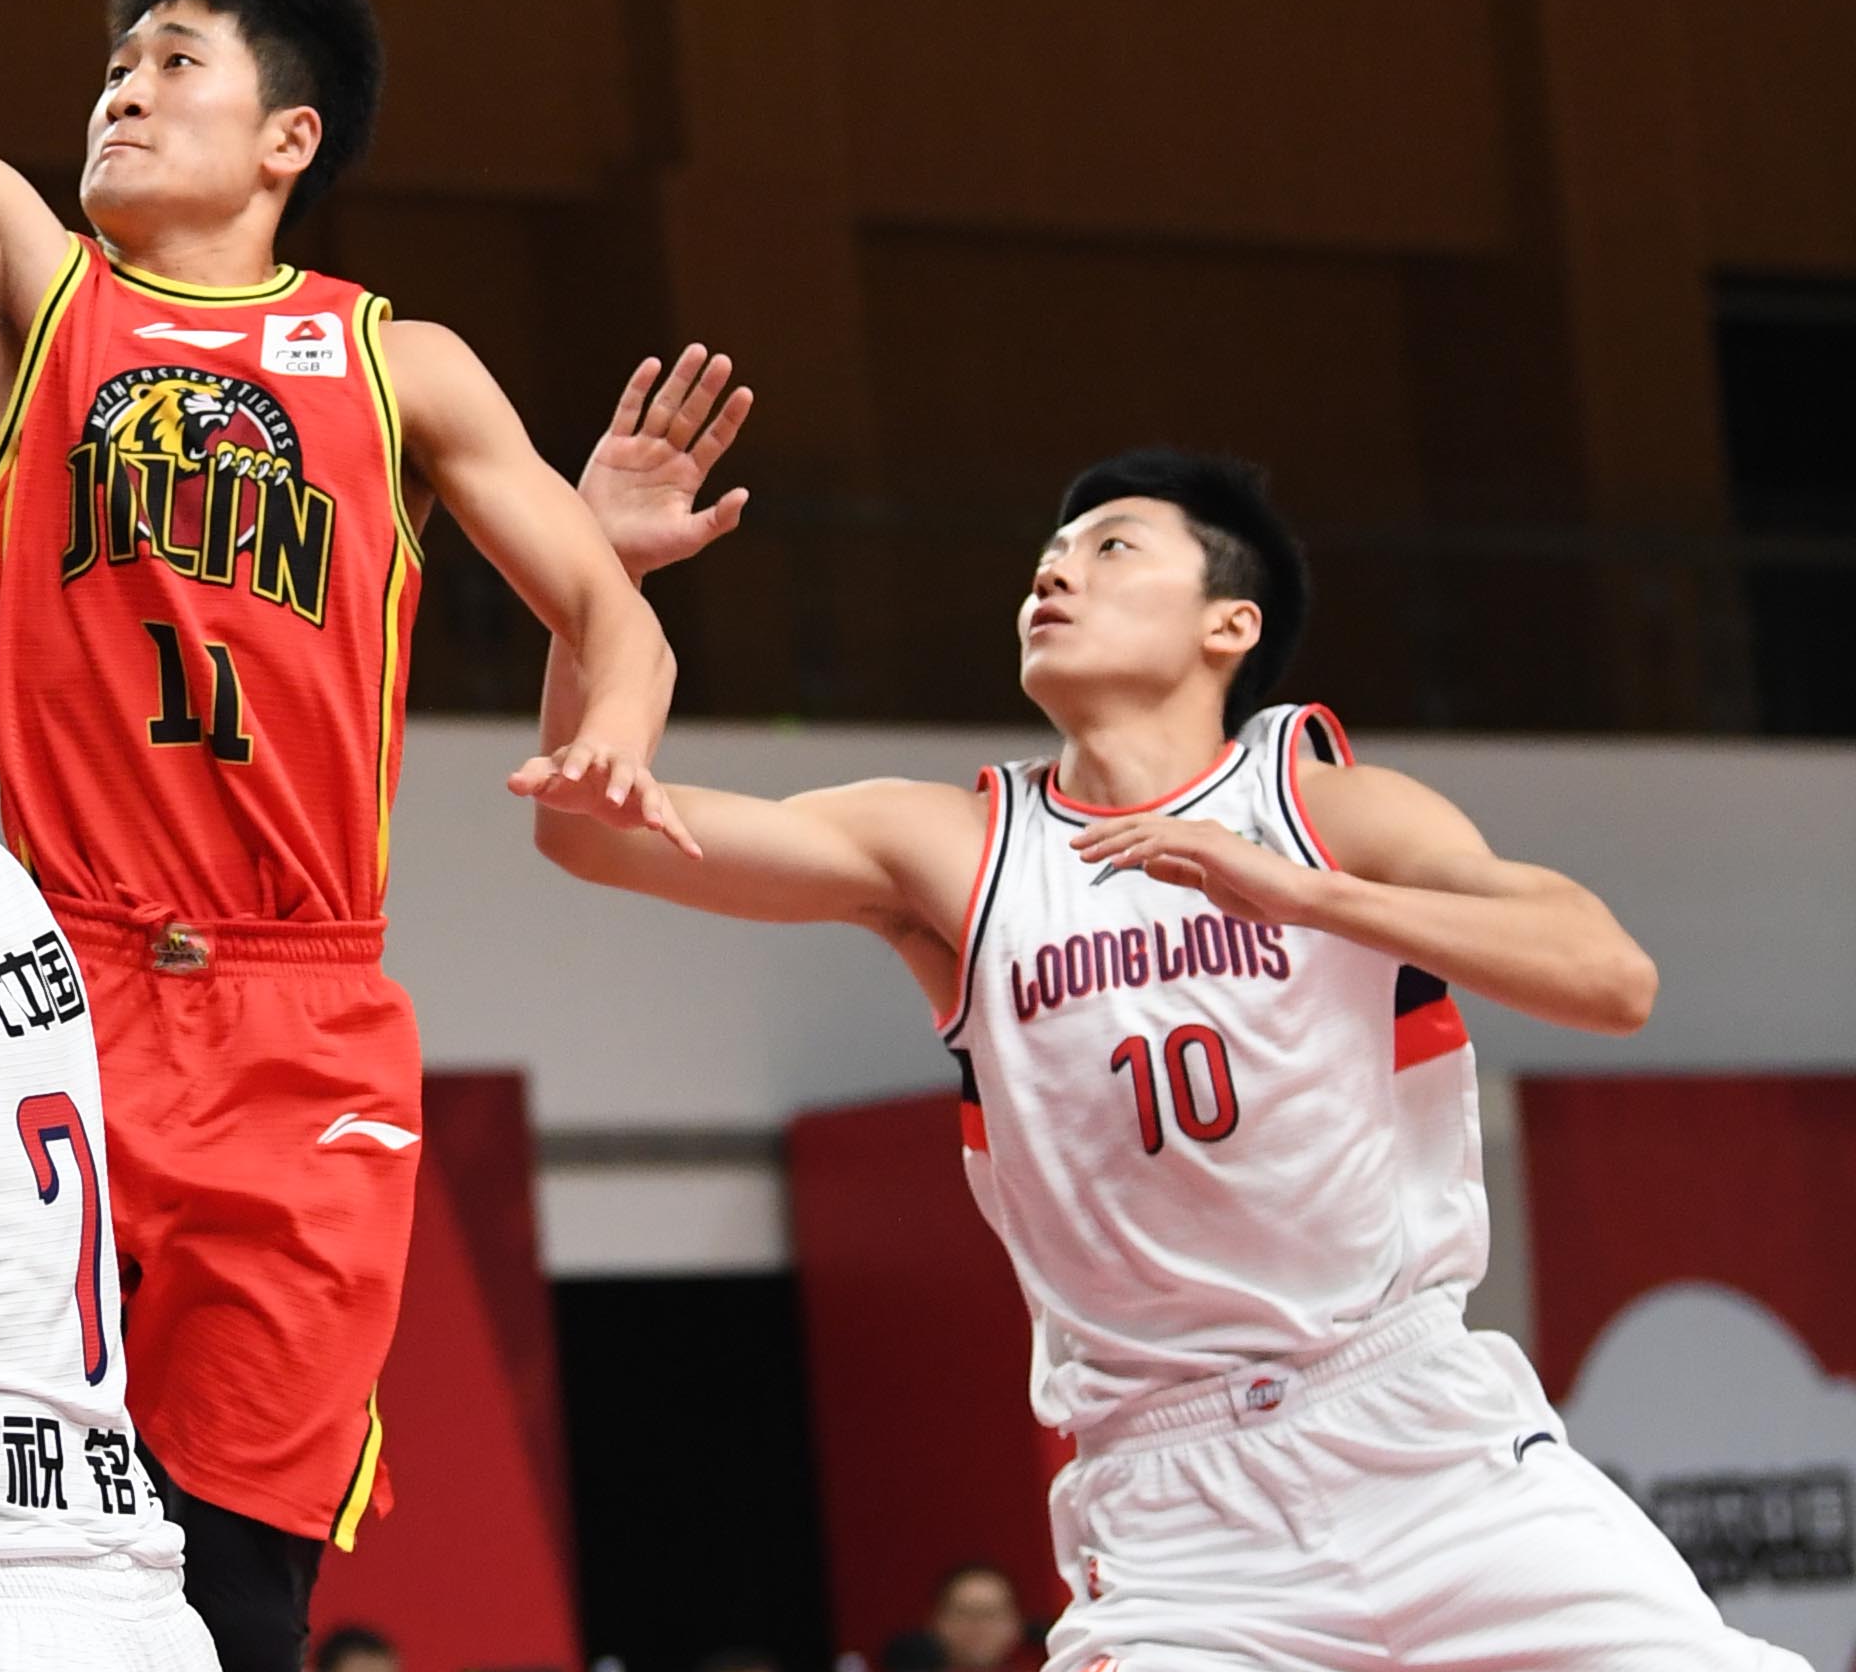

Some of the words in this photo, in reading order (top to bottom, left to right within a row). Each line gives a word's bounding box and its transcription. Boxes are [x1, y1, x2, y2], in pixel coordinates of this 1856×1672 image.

[90, 366, 235, 430] NTHEASTERN
[238, 382, 295, 451] TIGERS
[285, 361, 321, 372] CGB
[61, 440, 336, 628] JILIN
[142, 620, 254, 764] 11
[1011, 928, 1150, 1022] LOONG
[1153, 913, 1292, 982] LIONS
[1110, 1023, 1240, 1156] 10
[15, 1091, 108, 1387] 7
[2, 1415, 158, 1516] 祝铭
